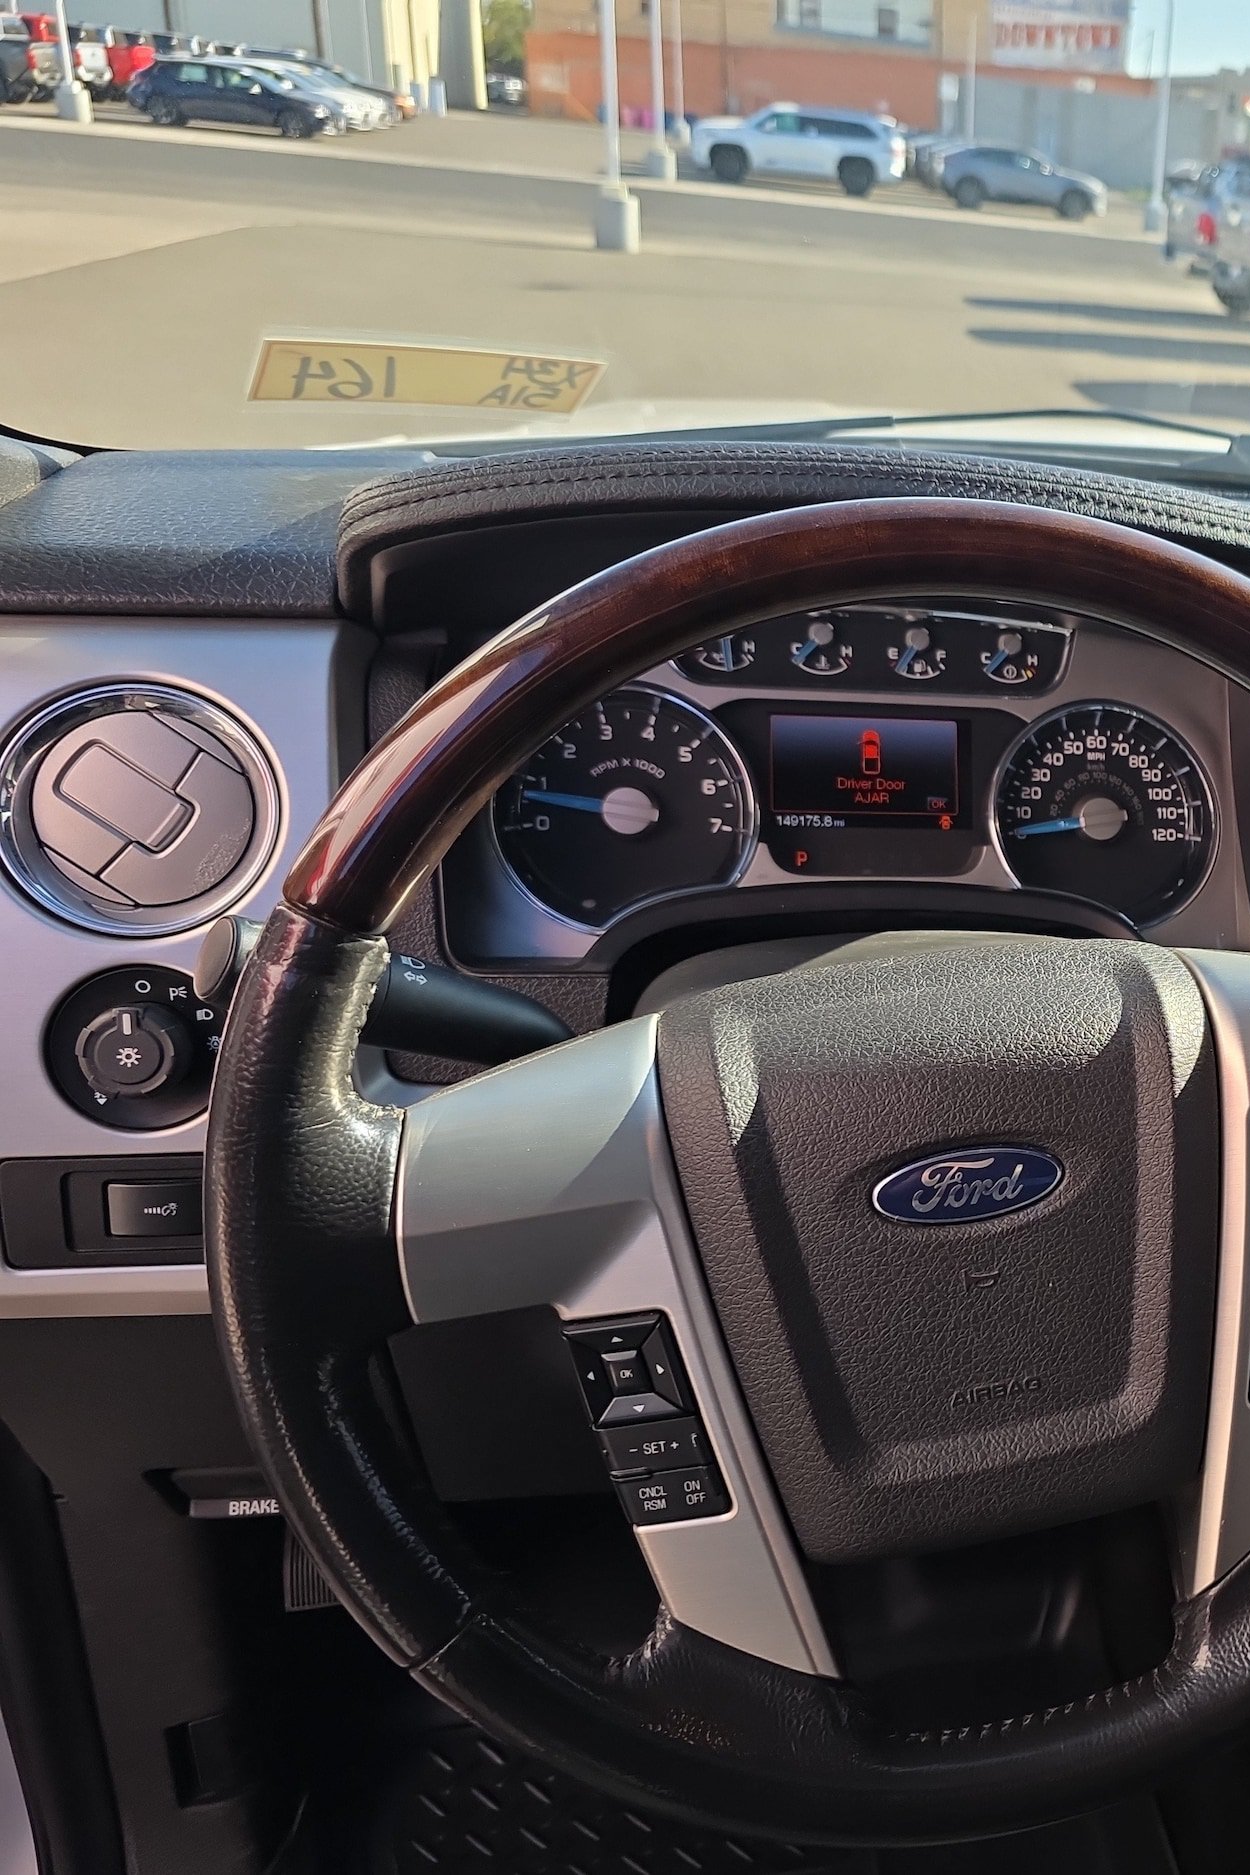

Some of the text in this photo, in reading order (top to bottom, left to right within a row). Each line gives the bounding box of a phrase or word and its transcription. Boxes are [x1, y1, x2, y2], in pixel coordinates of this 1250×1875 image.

[742, 640, 755, 653] H
[790, 642, 803, 655] C
[840, 645, 853, 658] H
[887, 647, 899, 660] E
[936, 650, 947, 662] F
[980, 652, 991, 664] C
[1027, 654, 1038, 667] H
[601, 725, 612, 740] 3
[641, 726, 655, 741] 4
[1063, 741, 1083, 755] 50
[1086, 735, 1107, 749] 60
[564, 744, 576, 759] 2
[678, 746, 692, 763] 5
[1111, 743, 1129, 756] 70
[1043, 753, 1064, 766] 40
[1087, 752, 1105, 761] MPH
[1129, 755, 1148, 768] 80
[590, 759, 619, 778] RPM
[634, 758, 666, 779] 1000
[1031, 769, 1051, 782] 30
[1141, 769, 1161, 782] 90
[541, 777, 547, 789] 1
[701, 779, 717, 795] 6
[837, 777, 906, 790] Driver Door
[855, 792, 889, 803] AJAR
[1021, 787, 1042, 800] 20
[1148, 788, 1172, 801] 100
[931, 800, 947, 809] OK
[1016, 806, 1031, 819] 10
[1157, 807, 1176, 820] 110
[535, 816, 550, 831] 0
[708, 817, 723, 833] 7
[776, 815, 833, 828] 149175.8
[1152, 828, 1176, 841] 120
[795, 851, 808, 866] P
[912, 1157, 1024, 1213] Ford
[620, 1369, 633, 1379] OK
[951, 1377, 1042, 1410] AIRBAG
[643, 1440, 666, 1455] SET
[684, 1479, 700, 1492] ON
[638, 1486, 667, 1500] CNCL
[686, 1491, 706, 1506] OFF
[228, 1499, 280, 1516] BRAKE
[644, 1498, 667, 1511] RSM
